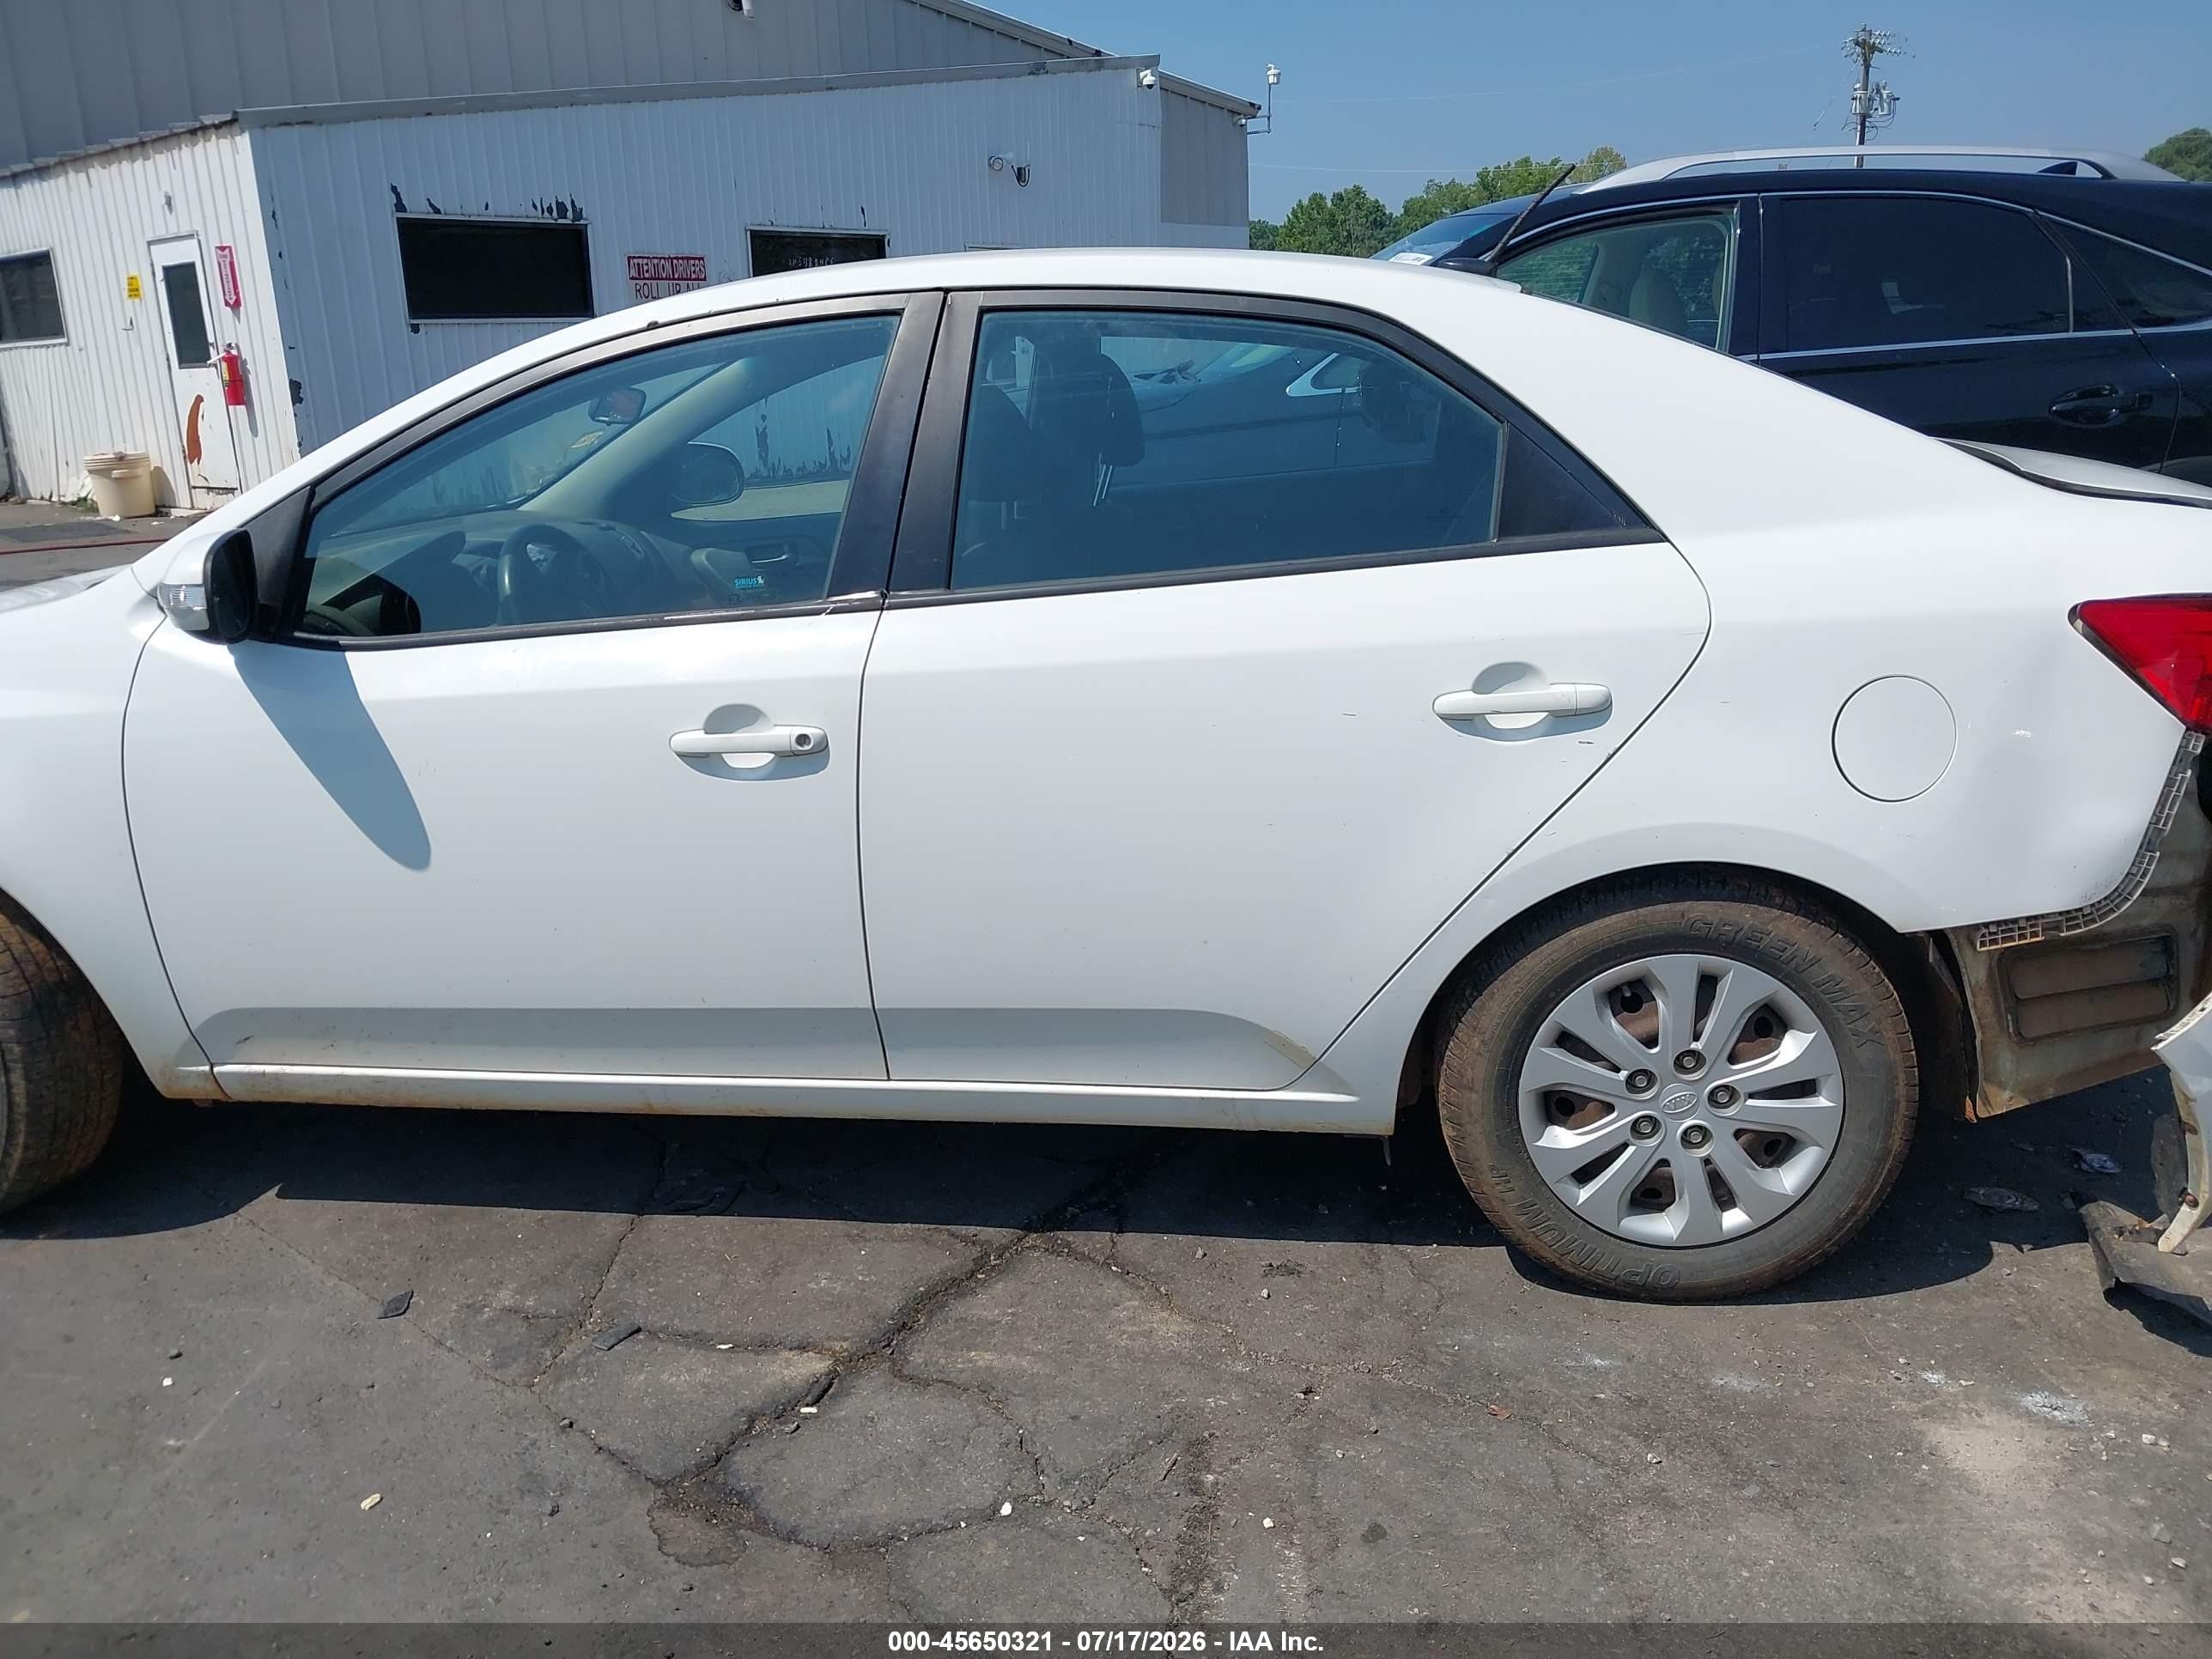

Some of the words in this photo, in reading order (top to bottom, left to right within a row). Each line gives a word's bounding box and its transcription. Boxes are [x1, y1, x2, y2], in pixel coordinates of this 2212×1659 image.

[629, 258, 672, 278] ATTENTION
[672, 260, 705, 279] DRIVERS
[635, 282, 661, 299] ROLL
[1683, 913, 1821, 974] GREEN
[1812, 971, 1884, 1048] MAX
[1509, 1197, 1681, 1288] OPTIMUM
